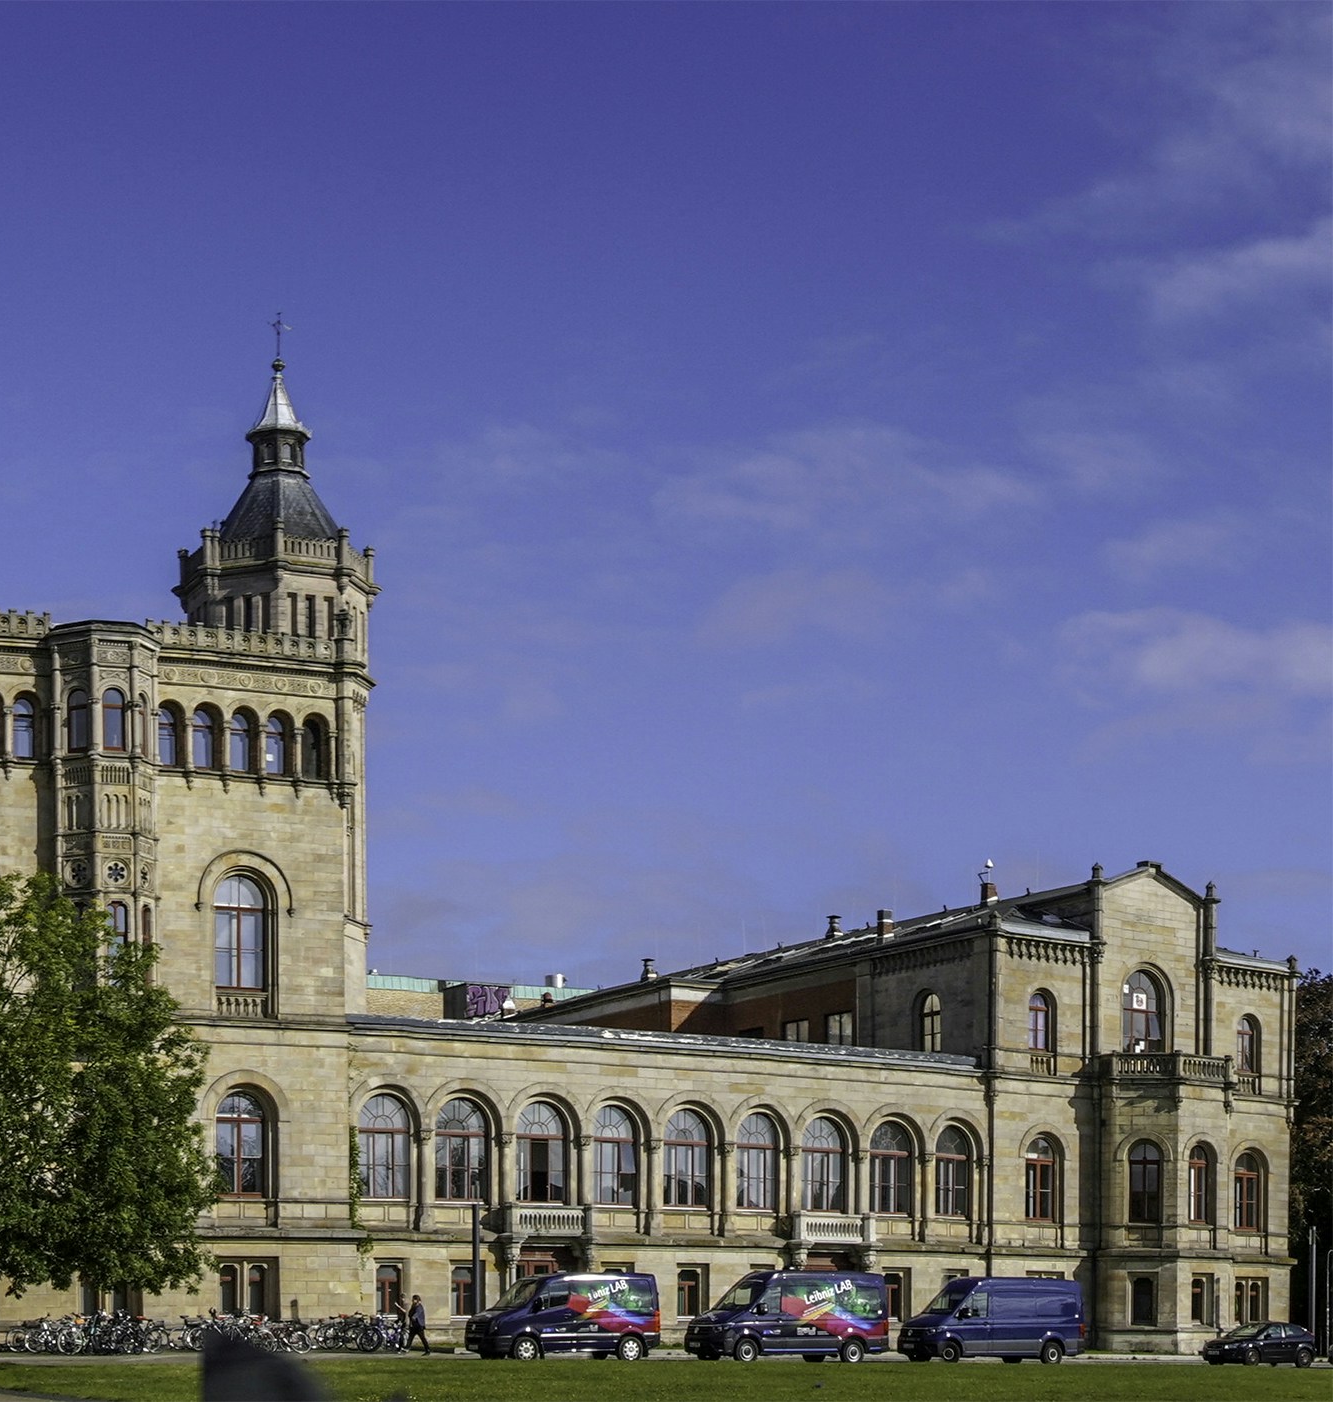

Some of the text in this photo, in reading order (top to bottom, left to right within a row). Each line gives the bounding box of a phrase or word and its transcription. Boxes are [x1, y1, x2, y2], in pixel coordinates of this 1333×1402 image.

[609, 1279, 629, 1294] LAB
[804, 1279, 853, 1304] Leibniz LAB
